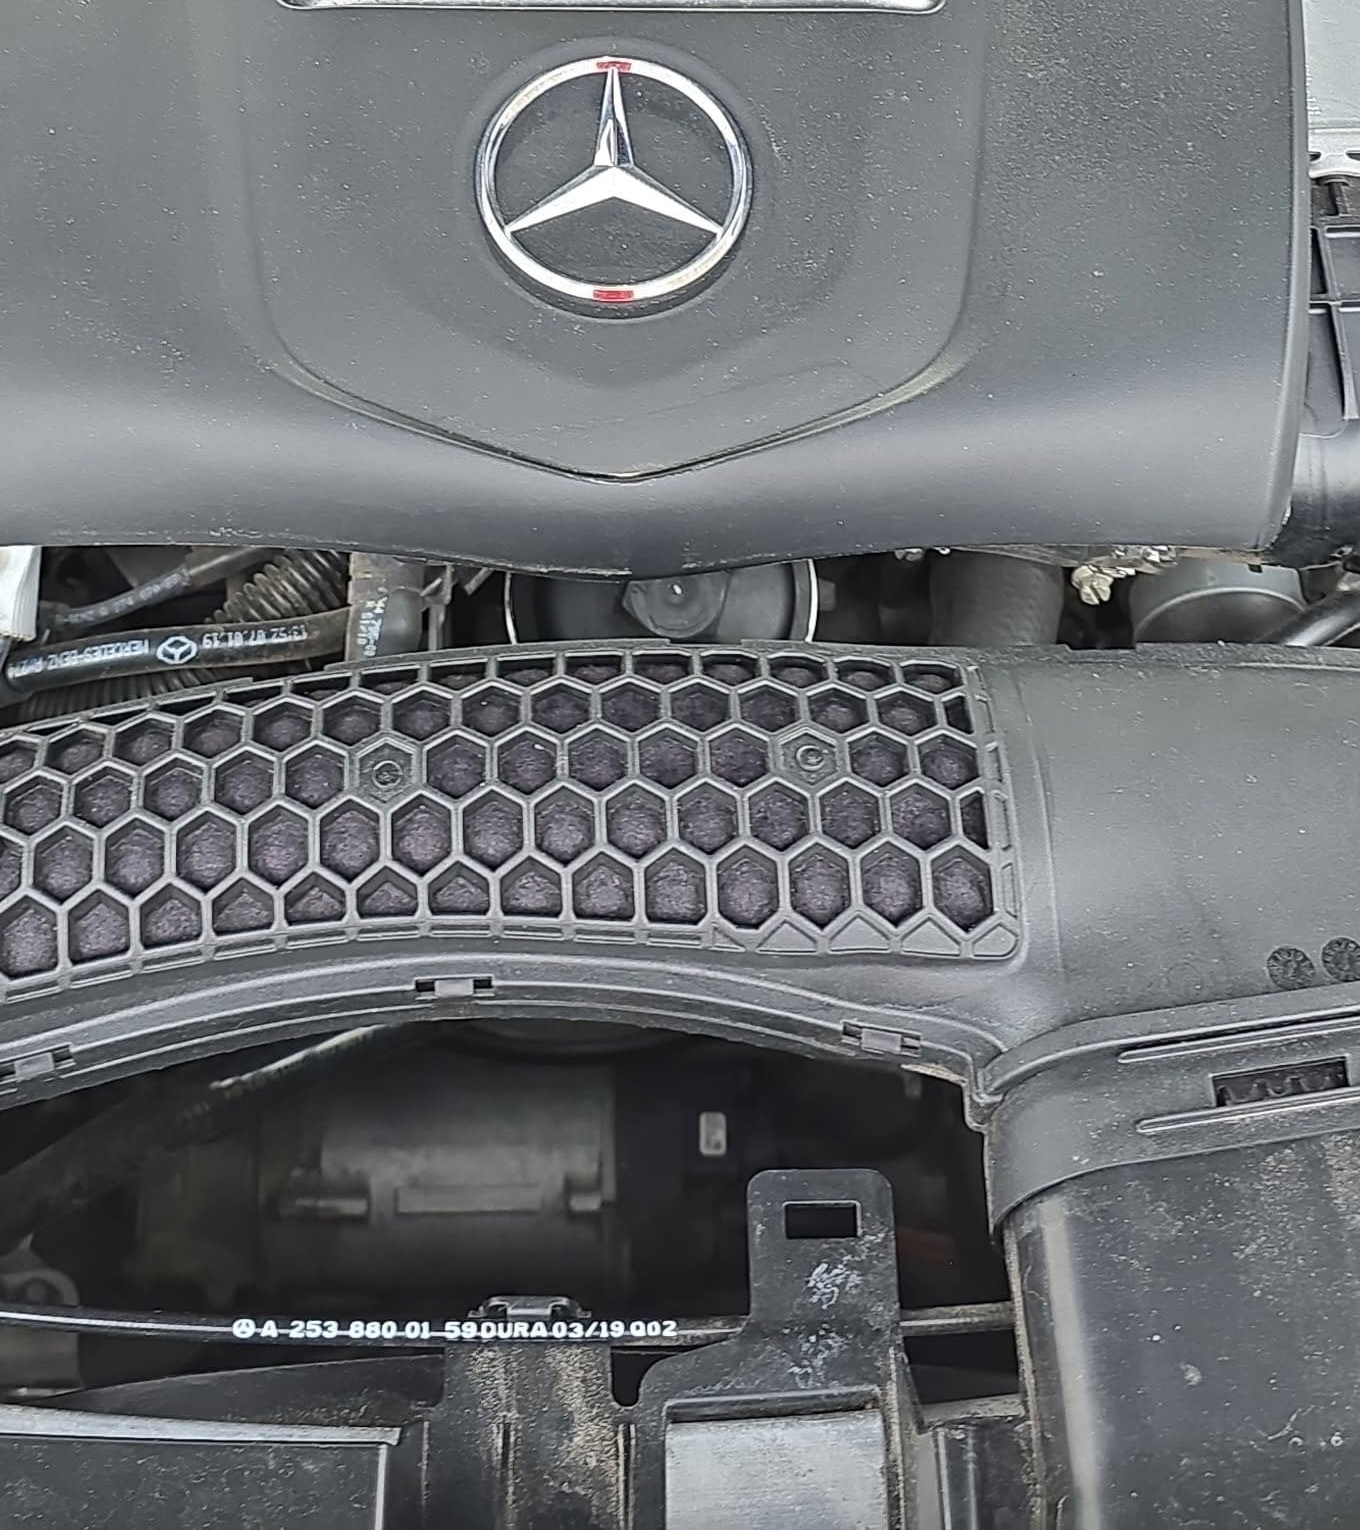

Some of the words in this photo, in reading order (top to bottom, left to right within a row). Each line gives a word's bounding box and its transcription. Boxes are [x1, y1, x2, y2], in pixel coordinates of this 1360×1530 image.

[259, 1321, 279, 1338] A
[288, 1321, 339, 1338] 253
[348, 1321, 398, 1338] 880
[403, 1321, 432, 1338] 01
